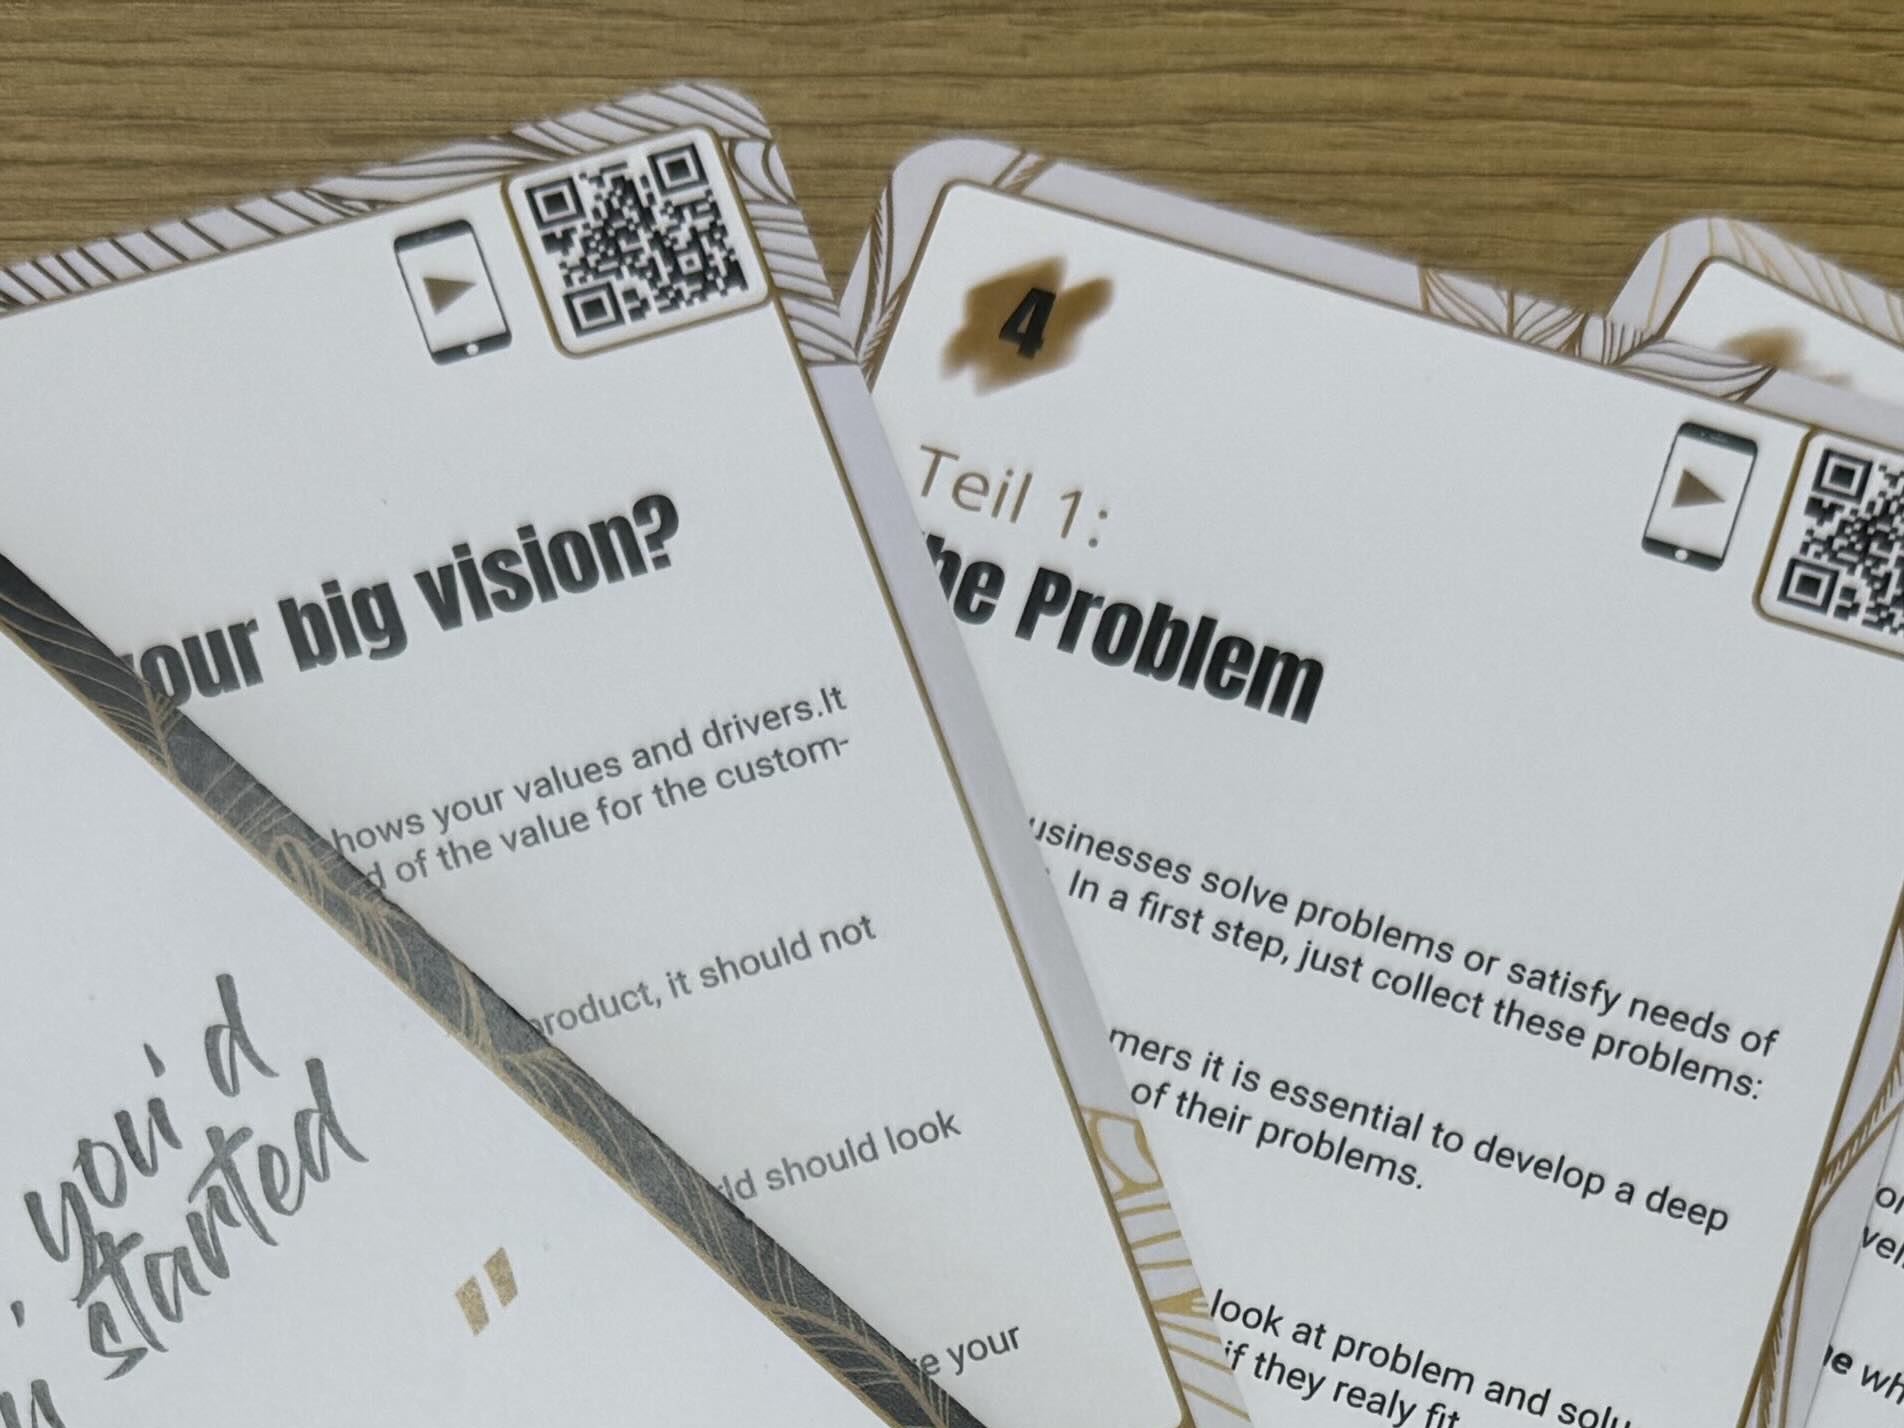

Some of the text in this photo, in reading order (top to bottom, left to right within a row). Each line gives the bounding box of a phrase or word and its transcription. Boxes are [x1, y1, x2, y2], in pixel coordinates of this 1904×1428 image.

[998, 286, 1057, 359] 4
[919, 444, 1108, 548] Teil 1:
[117, 493, 679, 708] our big vision?
[1015, 566, 1324, 724] Problem
[431, 788, 504, 835] your
[513, 756, 623, 804] values
[631, 727, 694, 770] and
[667, 970, 693, 999] it
[699, 929, 813, 989] should
[819, 914, 877, 953] not
[1068, 869, 1764, 1101] In a first step, just collect these problems:
[22, 972, 280, 1303] you'd
[765, 1109, 962, 1191] should look
[76, 1055, 370, 1382] started
[1253, 1351, 1327, 1402] they
[1332, 1380, 1418, 1428] realy
